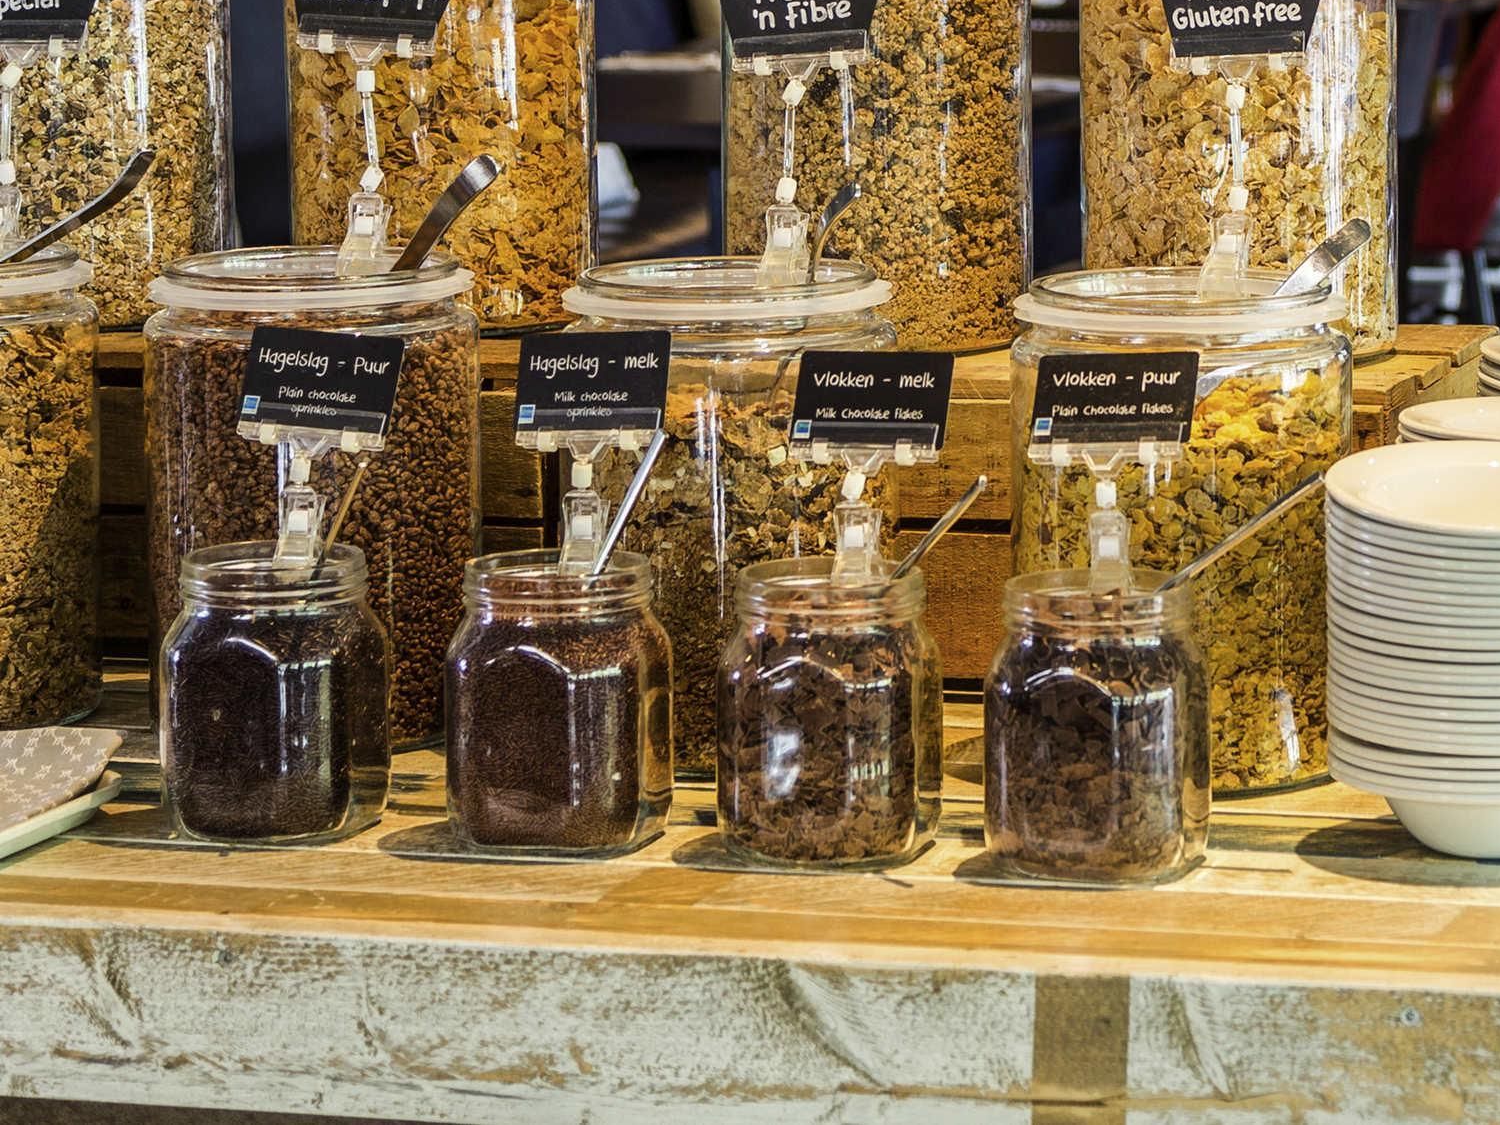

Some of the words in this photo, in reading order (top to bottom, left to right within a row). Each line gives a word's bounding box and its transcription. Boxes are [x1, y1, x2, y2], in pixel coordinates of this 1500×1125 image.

[258, 347, 329, 377] Hagelslag
[353, 356, 390, 375] Puur
[530, 354, 599, 379] Hagelslag
[624, 352, 659, 370] melk
[899, 372, 935, 389] melk
[278, 386, 304, 399] Plain
[554, 391, 575, 403] Milk
[815, 407, 837, 419] Milk
[1052, 404, 1079, 417] Plain
